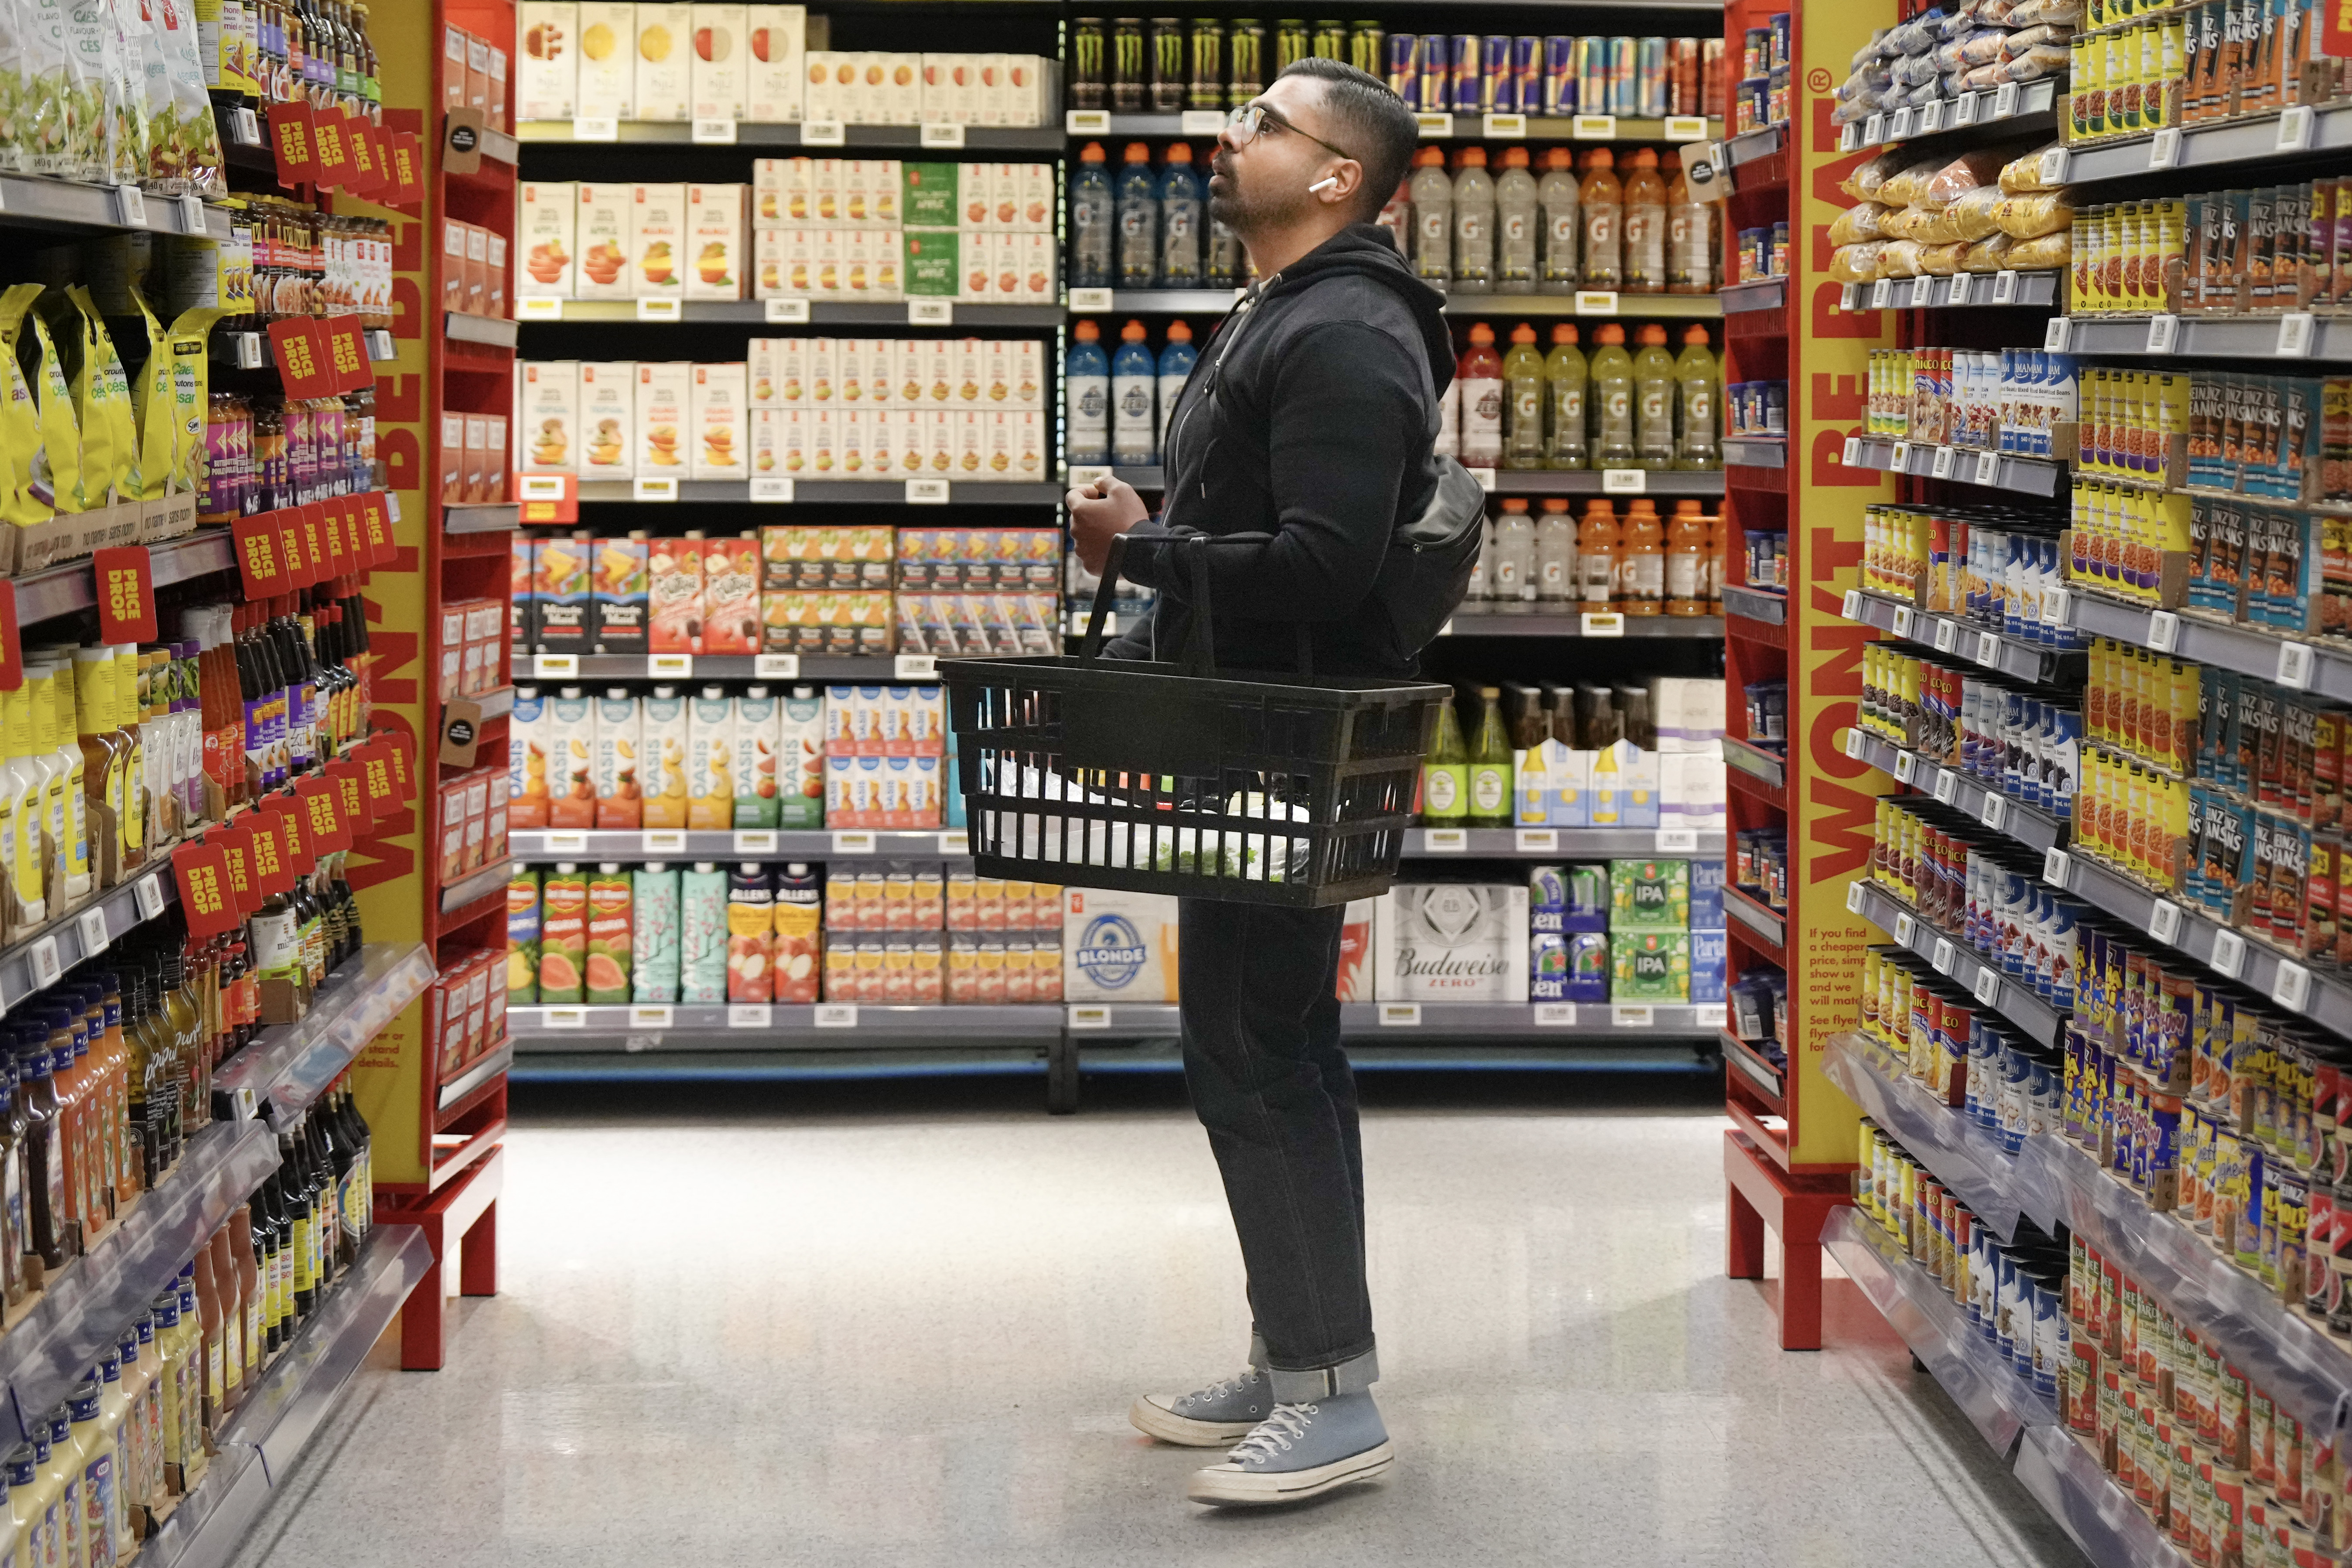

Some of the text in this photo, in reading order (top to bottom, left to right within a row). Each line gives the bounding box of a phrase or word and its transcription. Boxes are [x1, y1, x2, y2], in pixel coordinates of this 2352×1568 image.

[279, 123, 296, 165] DROP
[291, 121, 309, 163] PRICE
[315, 127, 333, 167] DROP
[325, 124, 345, 164] PRICE
[352, 133, 372, 171] PRICE
[1423, 213, 1441, 238] G
[1460, 214, 1478, 239] G
[1506, 214, 1523, 239] G
[1554, 215, 1570, 240] G
[1590, 216, 1609, 242] G
[282, 338, 303, 379] DROP
[294, 335, 315, 376] PRICE
[332, 335, 348, 374] DROP
[341, 332, 360, 371] PRICE
[1518, 392, 1536, 417] G
[1609, 393, 1626, 417] G
[1643, 393, 1663, 417] G
[1691, 393, 1709, 419] G
[1812, 373, 1881, 486] BE
[83, 533, 90, 547] no
[109, 525, 121, 540] sans
[144, 516, 151, 530] no
[168, 510, 179, 524] sans
[327, 517, 343, 556] PRICE
[367, 507, 384, 545] PRICE
[244, 536, 263, 580] DROP
[256, 534, 276, 577] PRICE
[283, 529, 301, 570] PRICE
[305, 523, 321, 563] PRICE
[1498, 561, 1514, 583] G
[1545, 561, 1560, 583] G
[108, 569, 126, 621] DROP
[123, 569, 141, 619] PRICE
[1809, 528, 1882, 884] WON'T
[373, 759, 390, 796] PRICE
[509, 739, 524, 798] OASIS
[553, 739, 567, 799] OASIS
[599, 739, 614, 799] OASIS
[646, 739, 660, 798] OASIS
[693, 739, 708, 799] OASIS
[738, 739, 752, 799] OASIS
[784, 739, 799, 799] OASIS
[307, 796, 325, 836] DROP
[319, 793, 337, 833] PRICE
[346, 778, 361, 816] PRICE
[260, 831, 280, 874] PRICE
[284, 814, 301, 855] PRICE
[202, 865, 223, 912] PRICE
[231, 848, 248, 892] PRICE
[187, 868, 209, 914] DROP
[1635, 885, 1664, 902] IPA
[1810, 927, 1867, 939] If you find
[1821, 941, 1865, 953] cheaper
[2055, 938, 2067, 946] Beans
[1078, 948, 1145, 965] BLONDE
[1395, 947, 1510, 977] Budweiser
[1637, 957, 1665, 973] IPA
[1810, 956, 1839, 967] price,
[1810, 969, 1839, 978] show
[1429, 977, 1475, 987] ZERO
[1810, 982, 1831, 992] and
[1810, 995, 1829, 1005] will
[1810, 1015, 1829, 1025] See
[2010, 1086, 2021, 1095] Beans
[2033, 1099, 2045, 1108] Beans
[2084, 1413, 2093, 1421] 425
